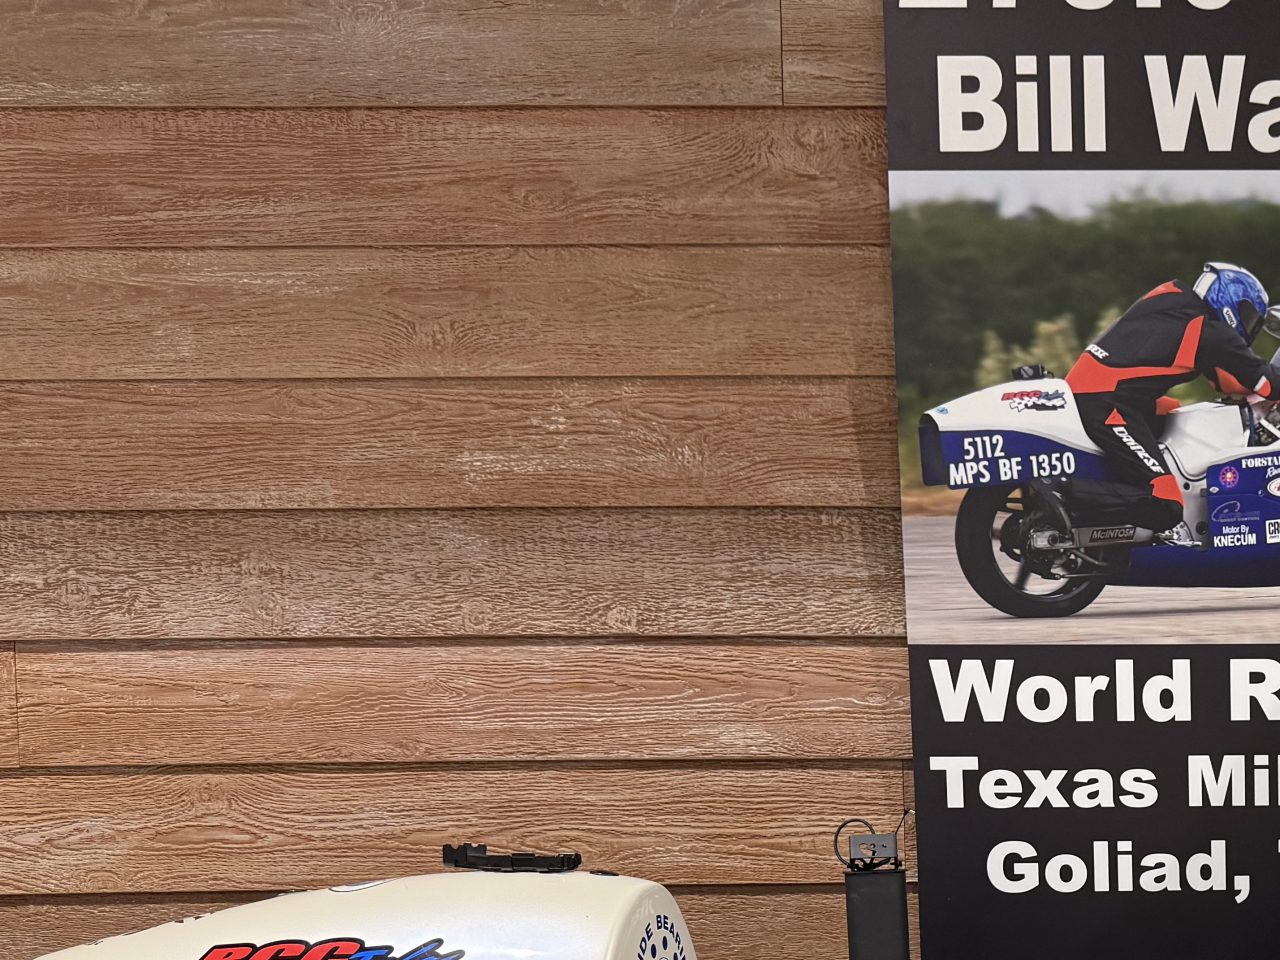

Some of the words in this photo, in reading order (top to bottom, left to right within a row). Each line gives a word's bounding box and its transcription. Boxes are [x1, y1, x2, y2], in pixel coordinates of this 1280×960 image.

[937, 55, 1107, 153] Bill
[949, 464, 991, 486] MPS
[1000, 457, 1022, 480] BF
[1030, 452, 1076, 478] 1350
[964, 435, 1005, 460] 5112
[1214, 534, 1256, 547] KNECUM
[1223, 526, 1239, 534] Motor
[1241, 525, 1249, 535] By
[928, 657, 1193, 723] World
[930, 756, 1159, 809] Texas
[986, 840, 1251, 905] Goliad,
